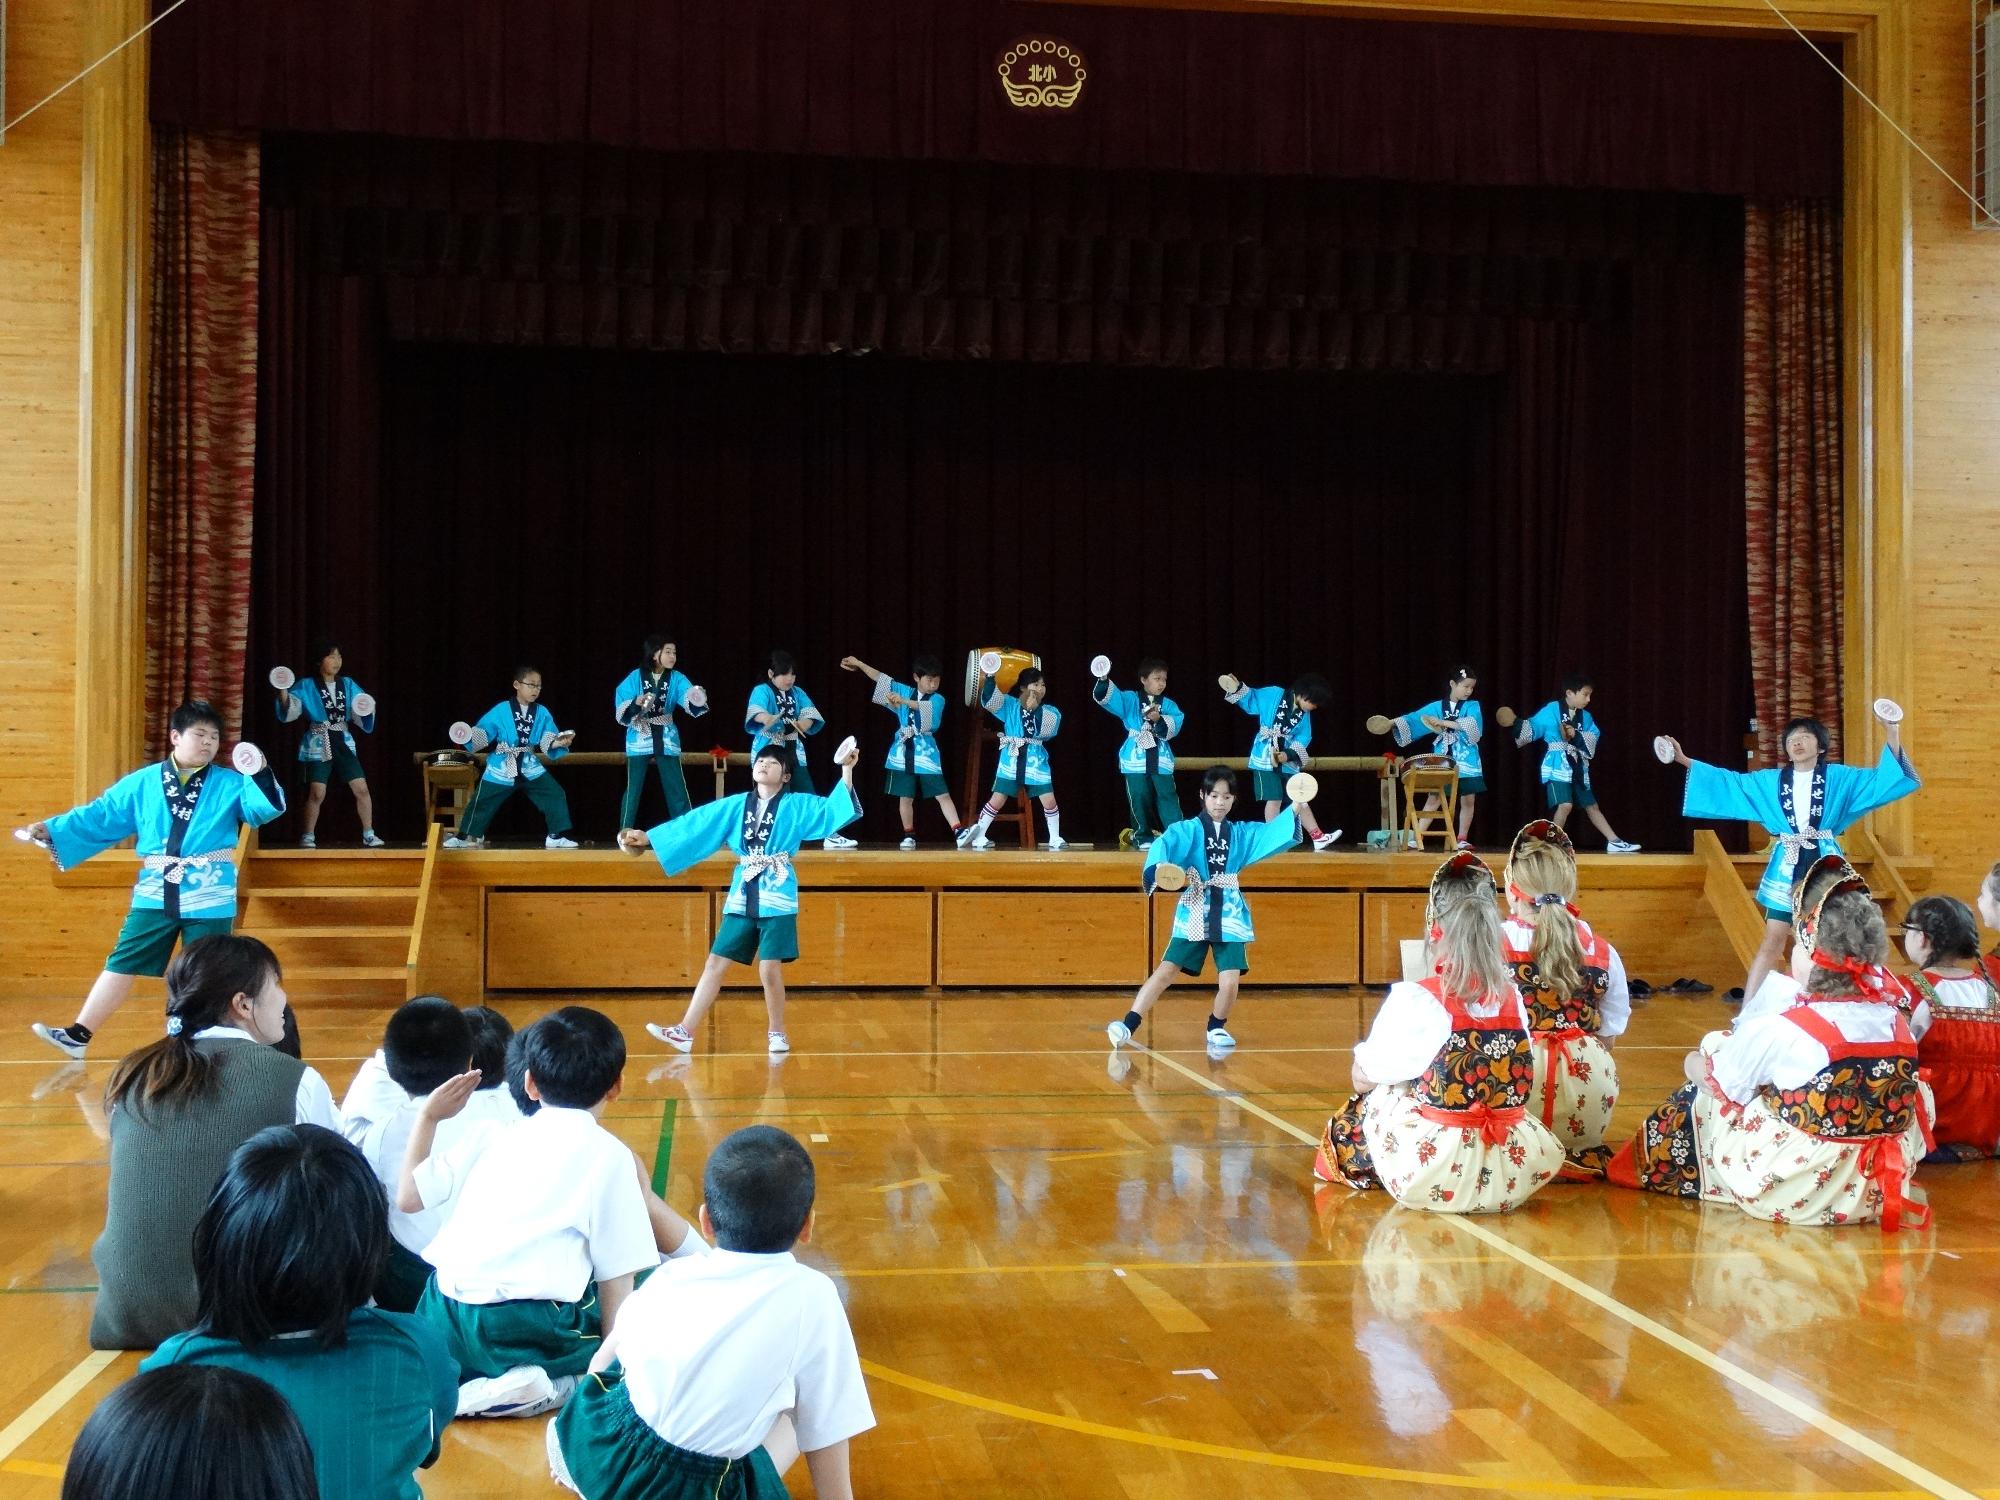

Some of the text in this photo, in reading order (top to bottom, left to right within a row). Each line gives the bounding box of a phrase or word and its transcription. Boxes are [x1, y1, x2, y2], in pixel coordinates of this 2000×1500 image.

[1028, 64, 1057, 82] 北小
[178, 777, 203, 821] ふせ村
[1810, 774, 1826, 817] ふせ村
